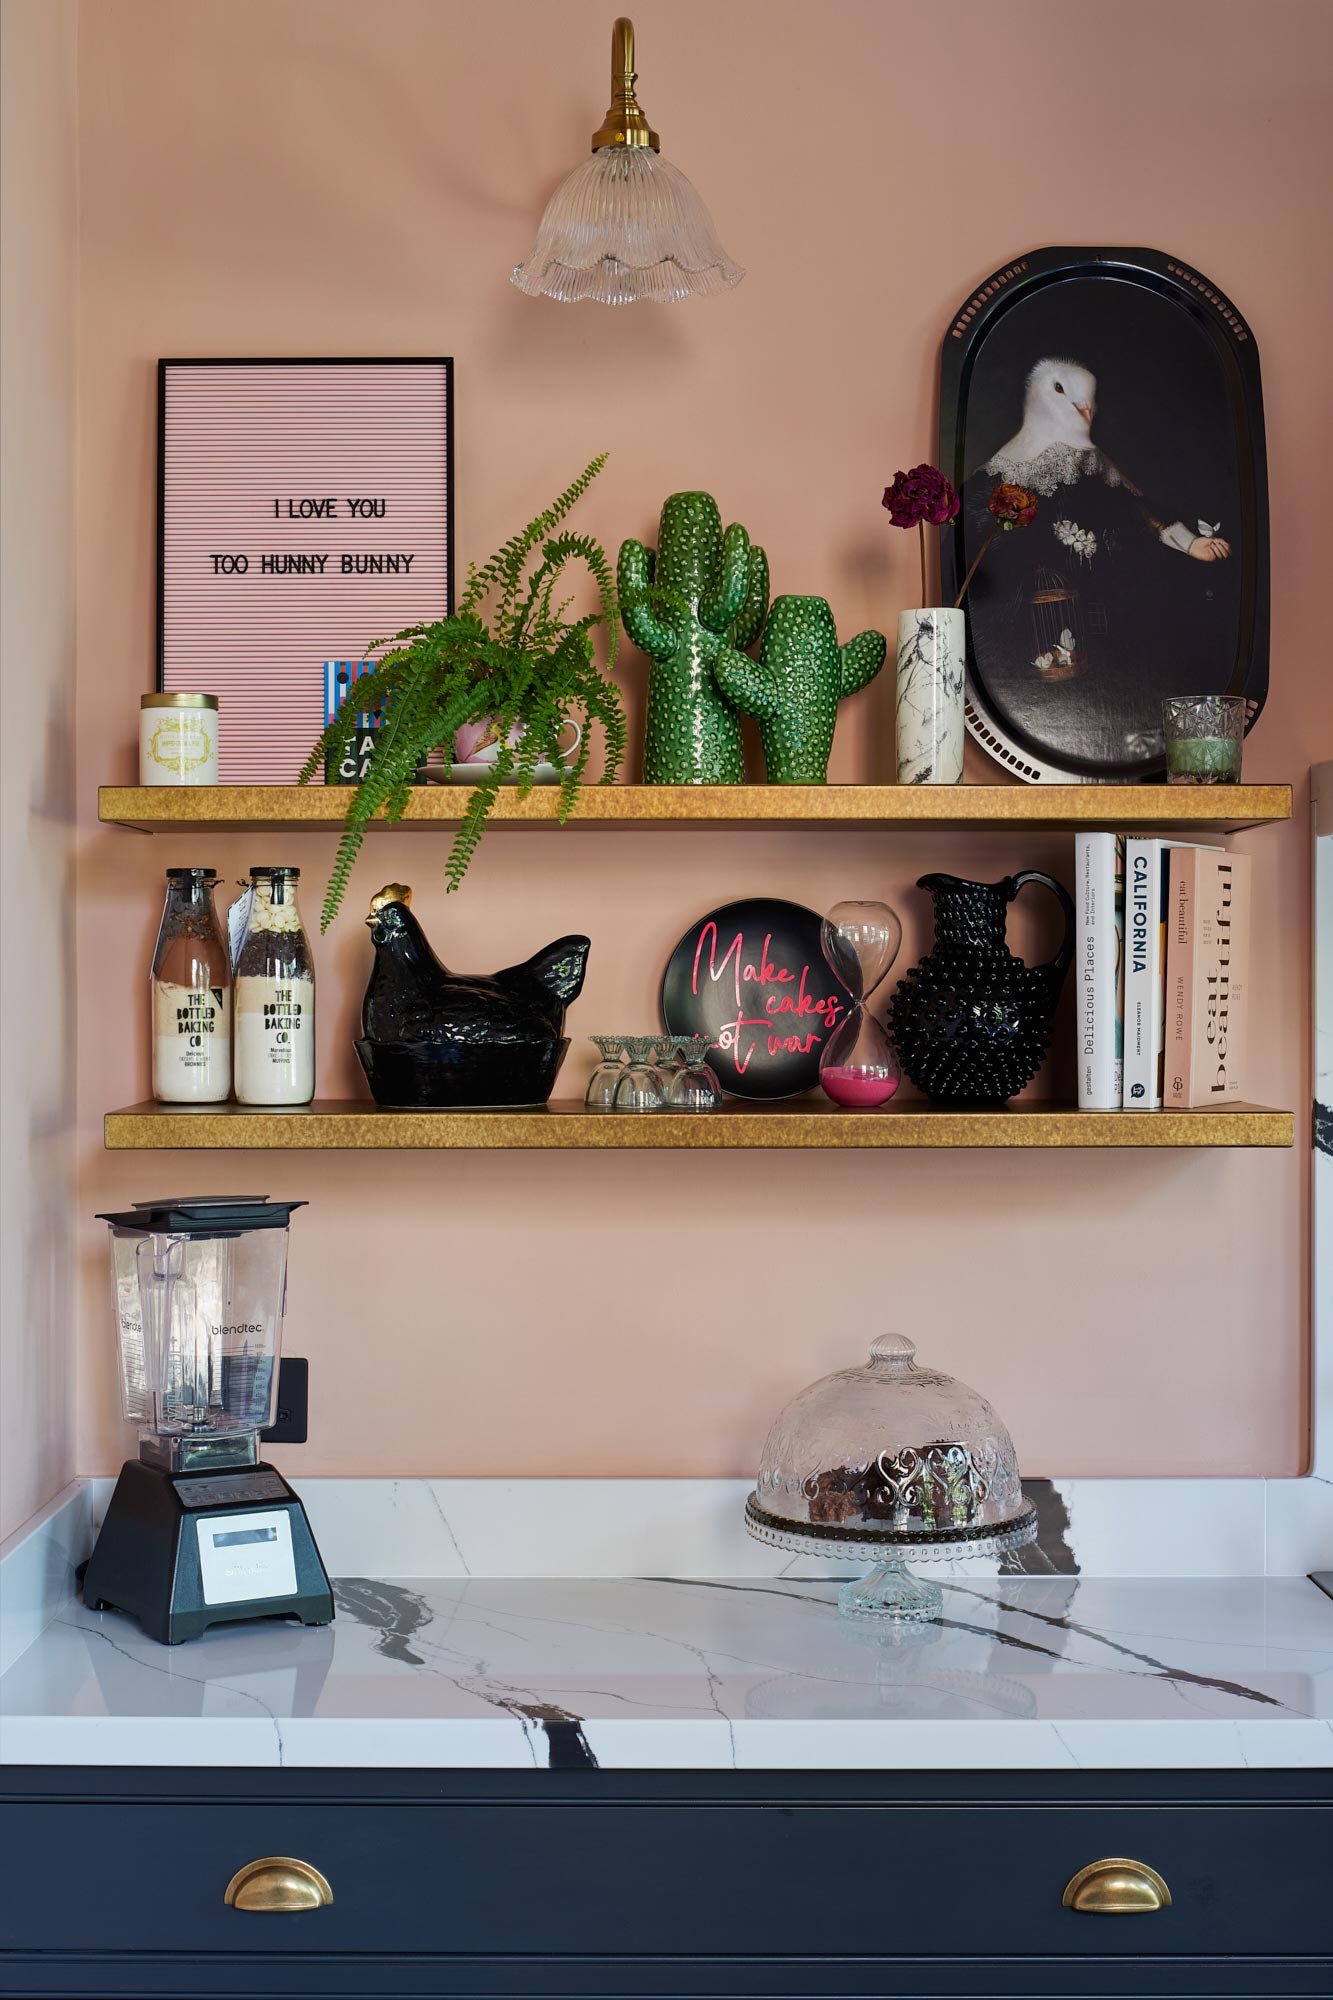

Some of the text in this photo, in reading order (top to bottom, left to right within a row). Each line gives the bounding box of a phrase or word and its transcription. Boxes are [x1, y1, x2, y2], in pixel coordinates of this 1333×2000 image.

[274, 498, 386, 519] I LOVE YOU
[209, 554, 415, 575] TOO HUNNY BUNNY
[1132, 856, 1148, 973] CALIFORNIA
[1178, 896, 1188, 944] beautiful
[692, 921, 796, 1007] Make
[1211, 861, 1232, 1096] beautiful
[187, 993, 205, 1006] THE
[275, 990, 292, 1002] THE
[766, 965, 844, 1028] cakes
[1084, 936, 1095, 1055] Delicious Places
[176, 1007, 215, 1020] BOTTLED
[263, 1003, 302, 1016] BOTTLED
[1175, 976, 1184, 1041] WENDY ROWE
[1206, 968, 1218, 1045] eat
[178, 1021, 214, 1034] BAKING
[264, 1017, 301, 1030] BAKING
[189, 1035, 204, 1047] CO.
[276, 1031, 291, 1044] CO.
[767, 1032, 823, 1056] war
[211, 1323, 263, 1336] blendtec
